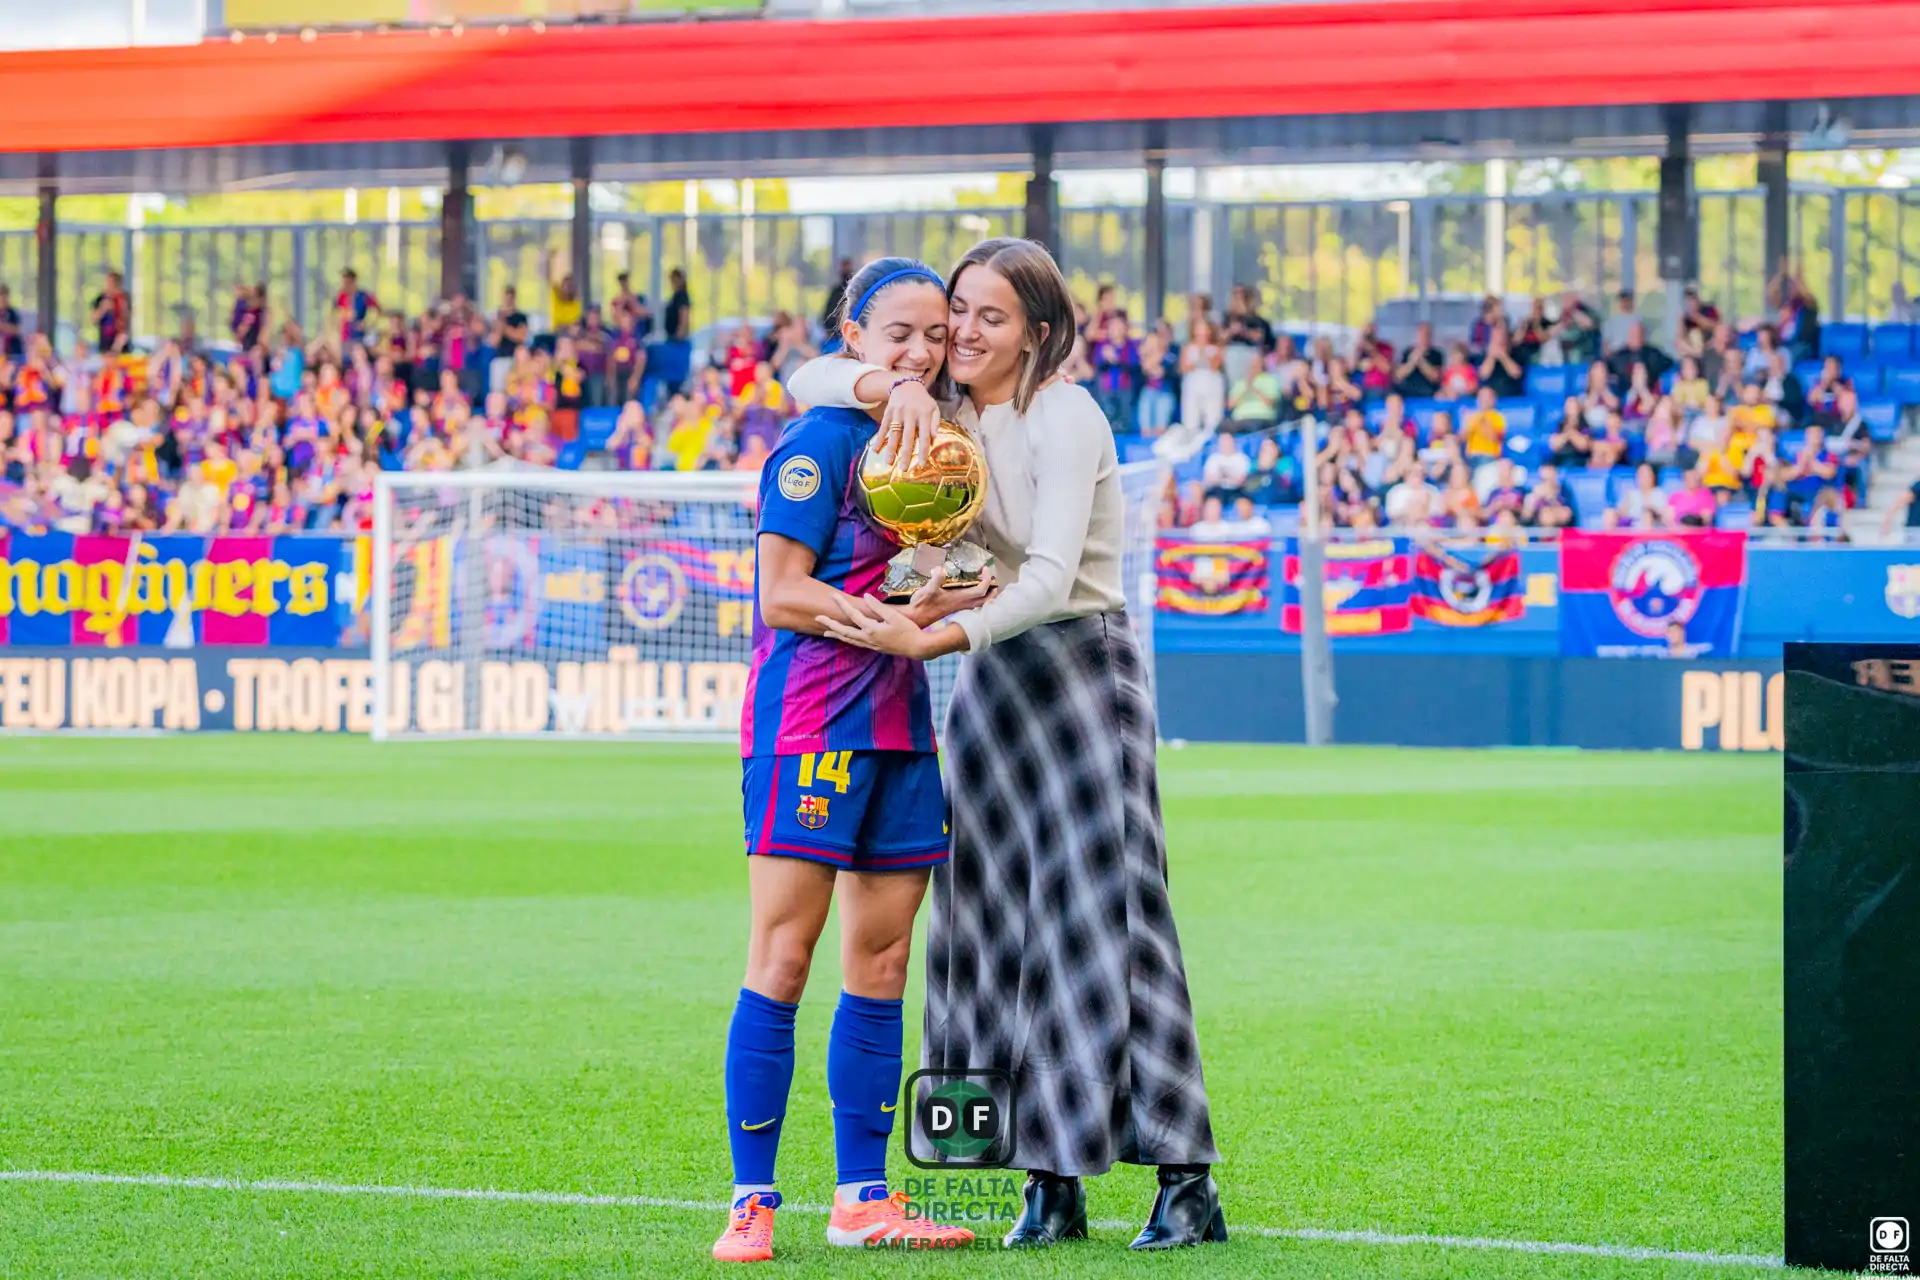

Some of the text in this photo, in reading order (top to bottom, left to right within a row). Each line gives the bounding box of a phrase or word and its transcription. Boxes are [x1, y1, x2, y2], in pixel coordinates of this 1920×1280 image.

[0, 657, 65, 730] EU
[71, 657, 200, 730] KOPA
[798, 751, 853, 793] 14
